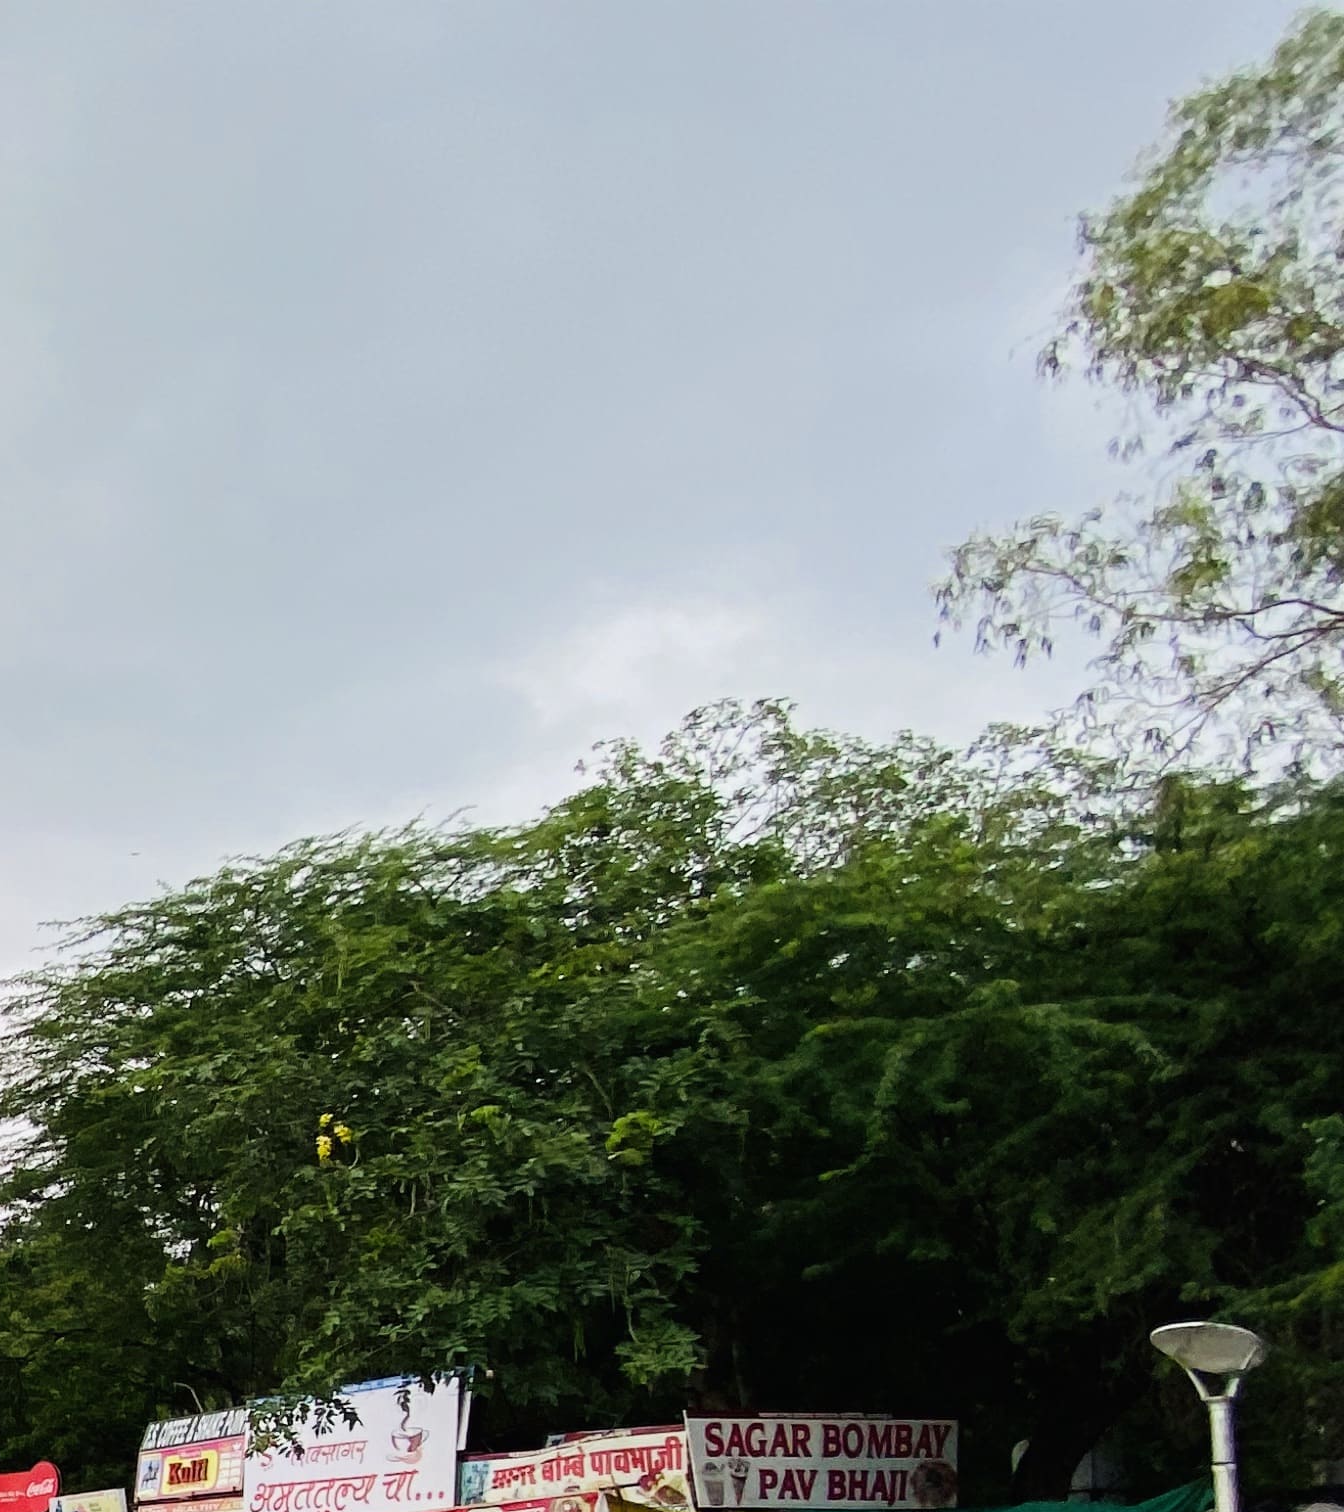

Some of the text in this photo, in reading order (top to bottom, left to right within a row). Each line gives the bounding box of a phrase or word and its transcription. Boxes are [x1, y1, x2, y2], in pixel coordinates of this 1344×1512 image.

[703, 1422, 953, 1459] SAGAR BOMBAY
[758, 1469, 910, 1506] PAV BHAJI
